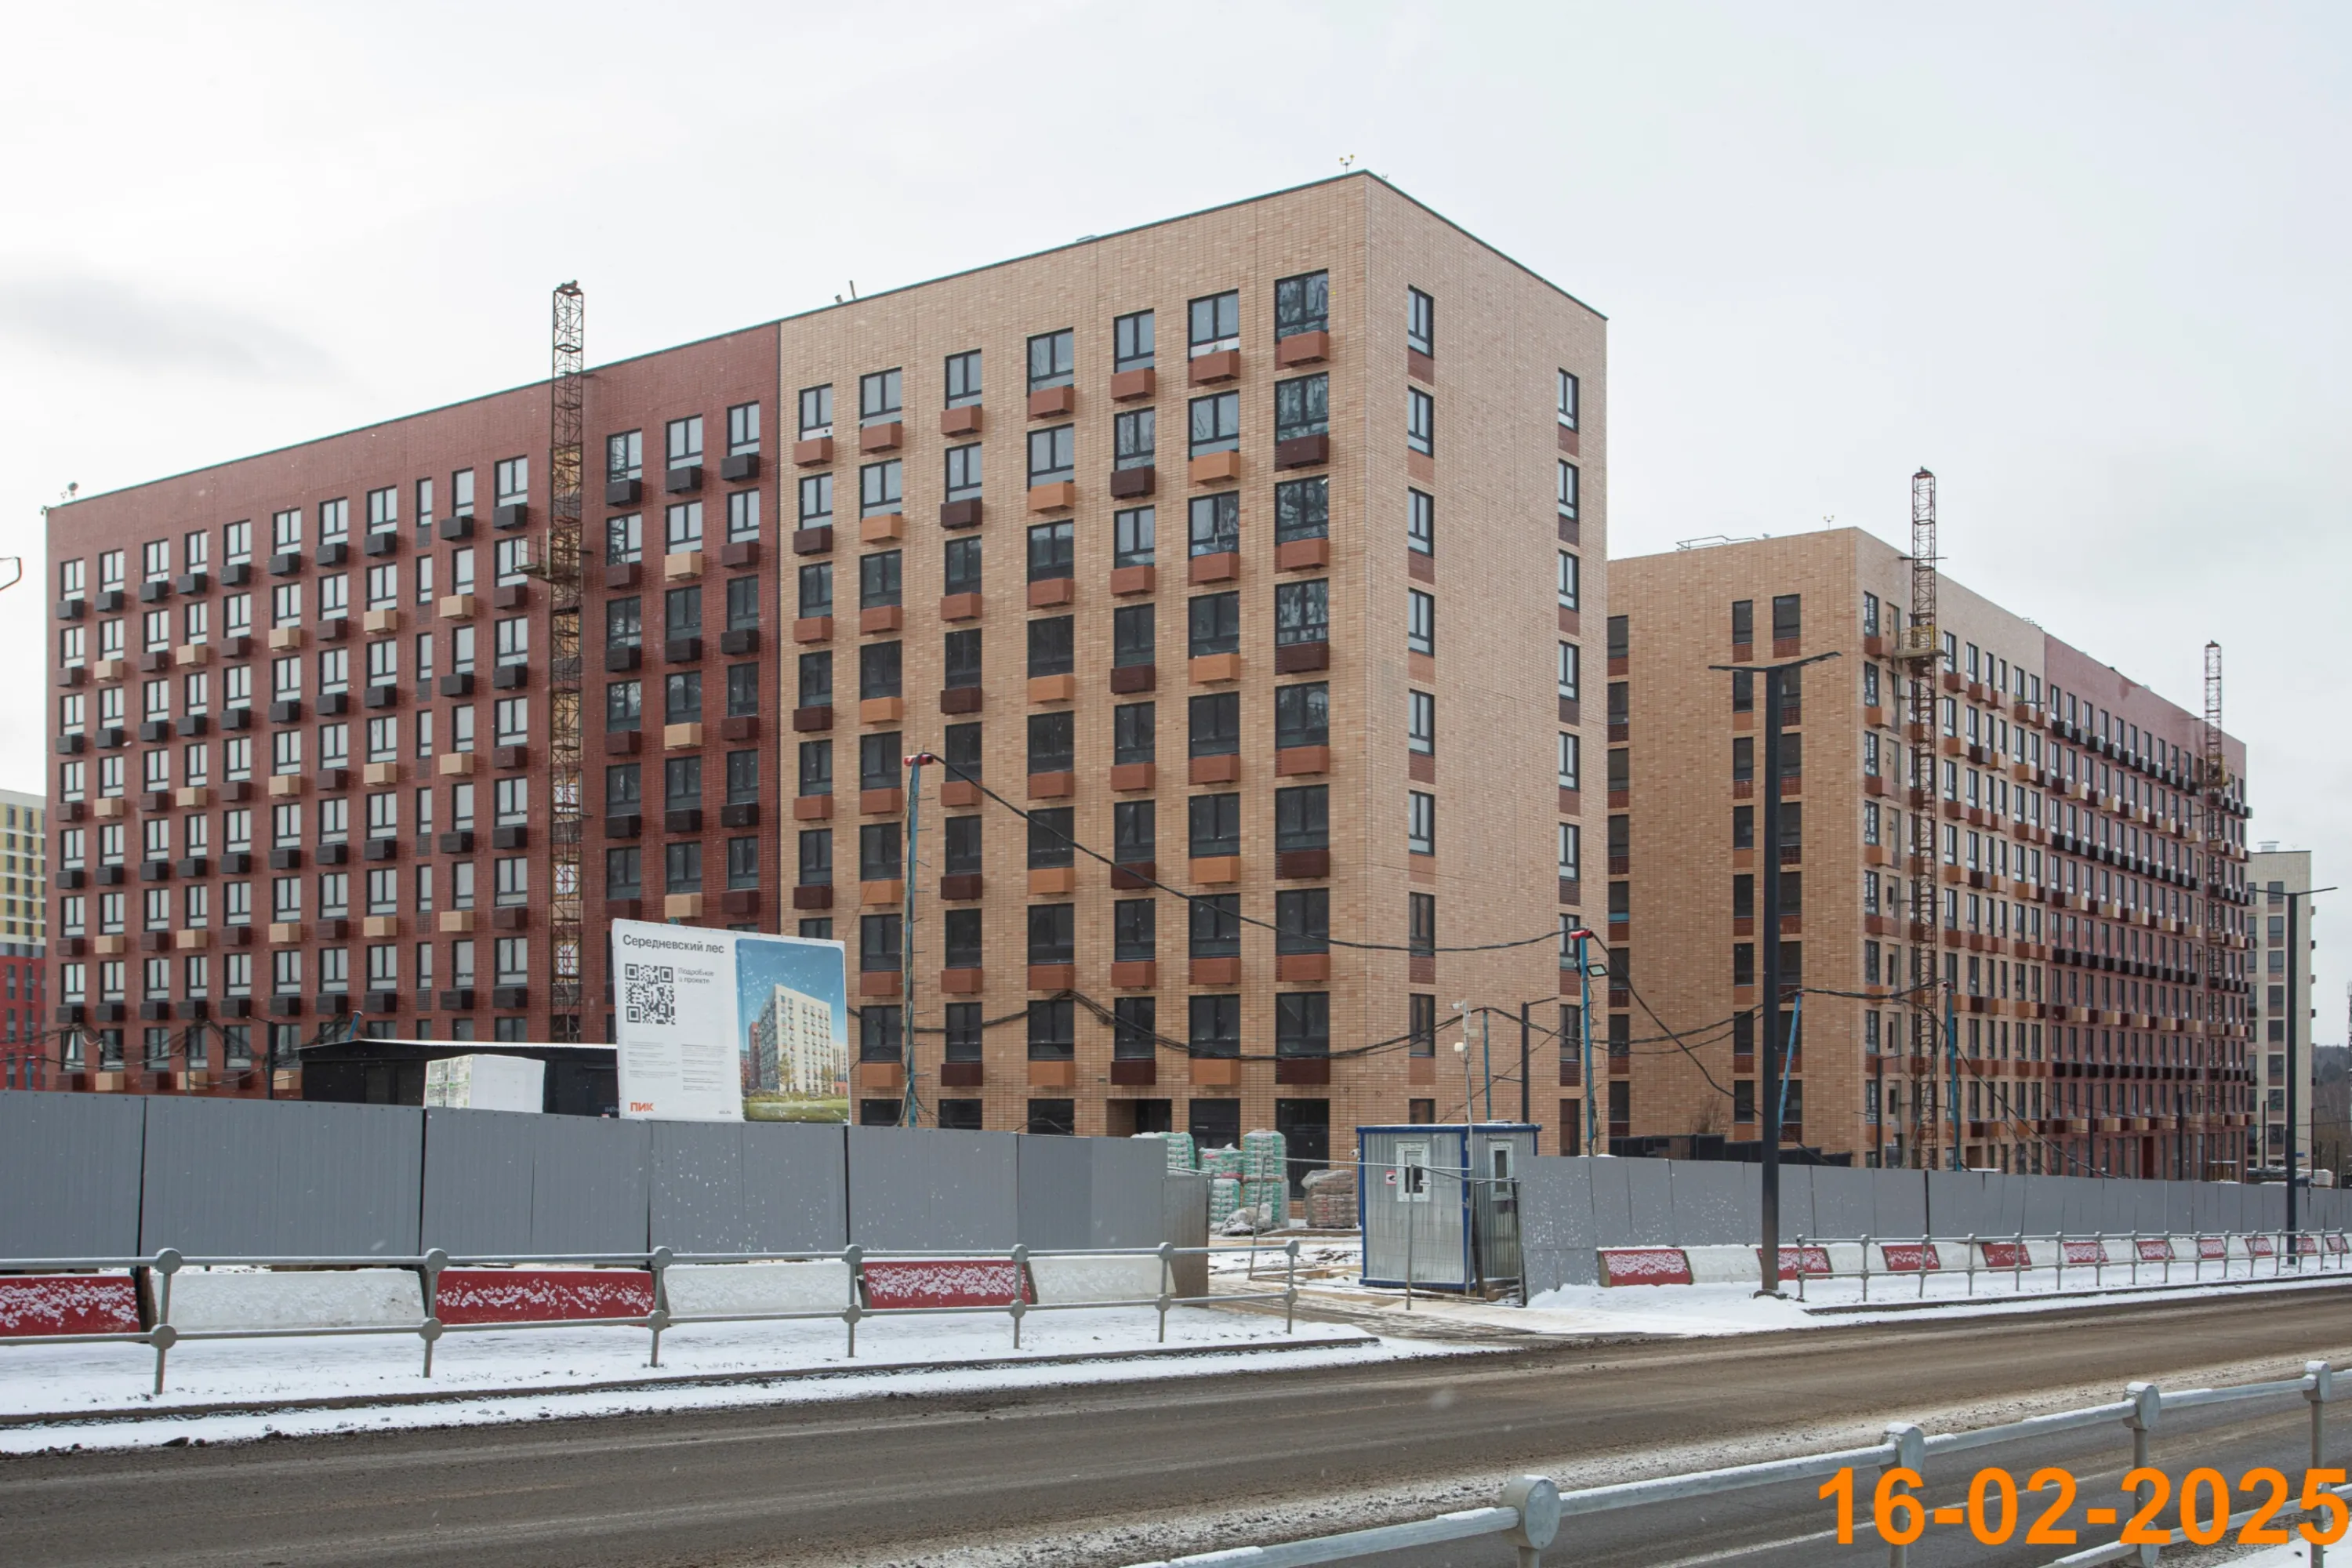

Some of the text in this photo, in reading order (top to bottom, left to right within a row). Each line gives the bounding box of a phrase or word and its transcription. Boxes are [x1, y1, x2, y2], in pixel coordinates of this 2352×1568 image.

[622, 935, 725, 954] Середневский лес
[630, 1102, 654, 1112] ПИК
